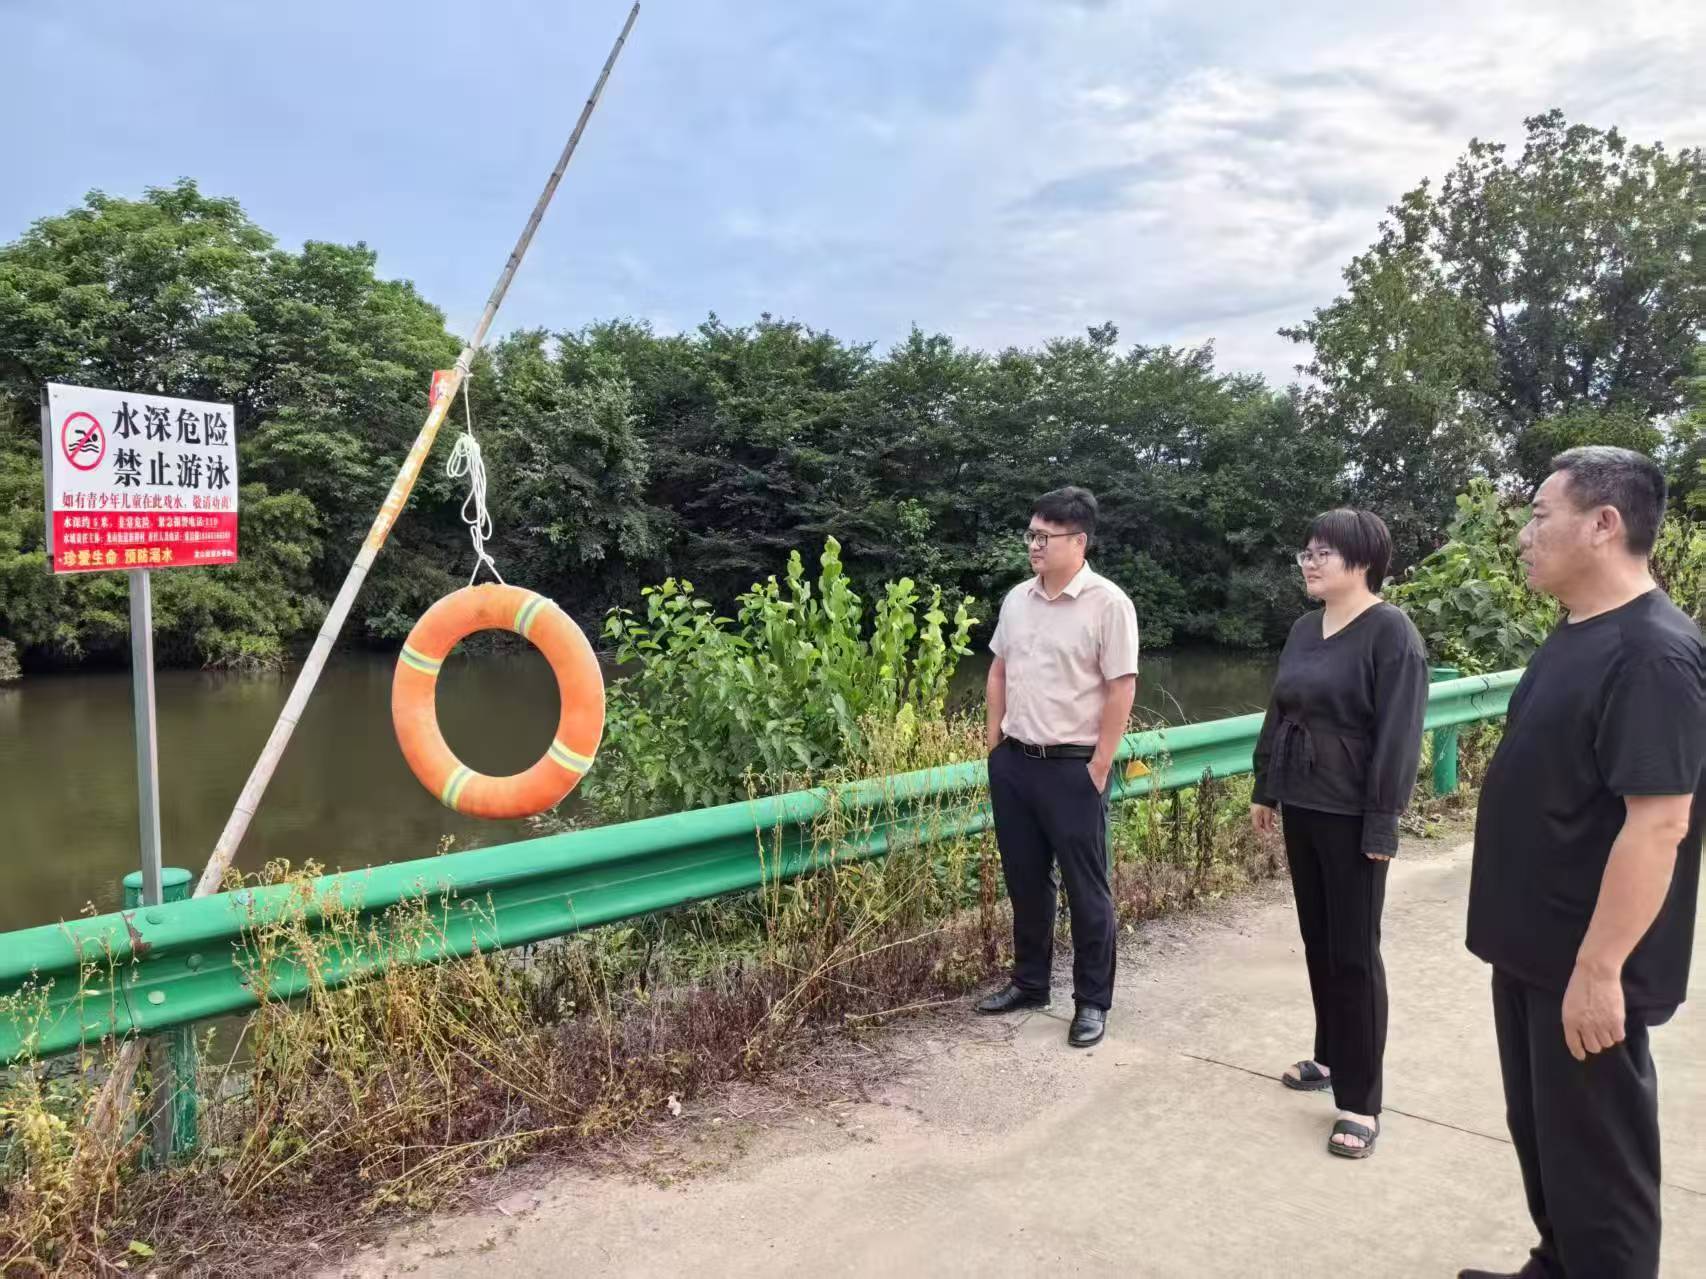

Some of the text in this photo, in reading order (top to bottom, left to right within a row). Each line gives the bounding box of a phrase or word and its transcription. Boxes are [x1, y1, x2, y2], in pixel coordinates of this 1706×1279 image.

[112, 401, 228, 446] 水深危险
[112, 448, 231, 490] 禁止游泳
[63, 547, 173, 567] 珍爱生命 预防溺水
